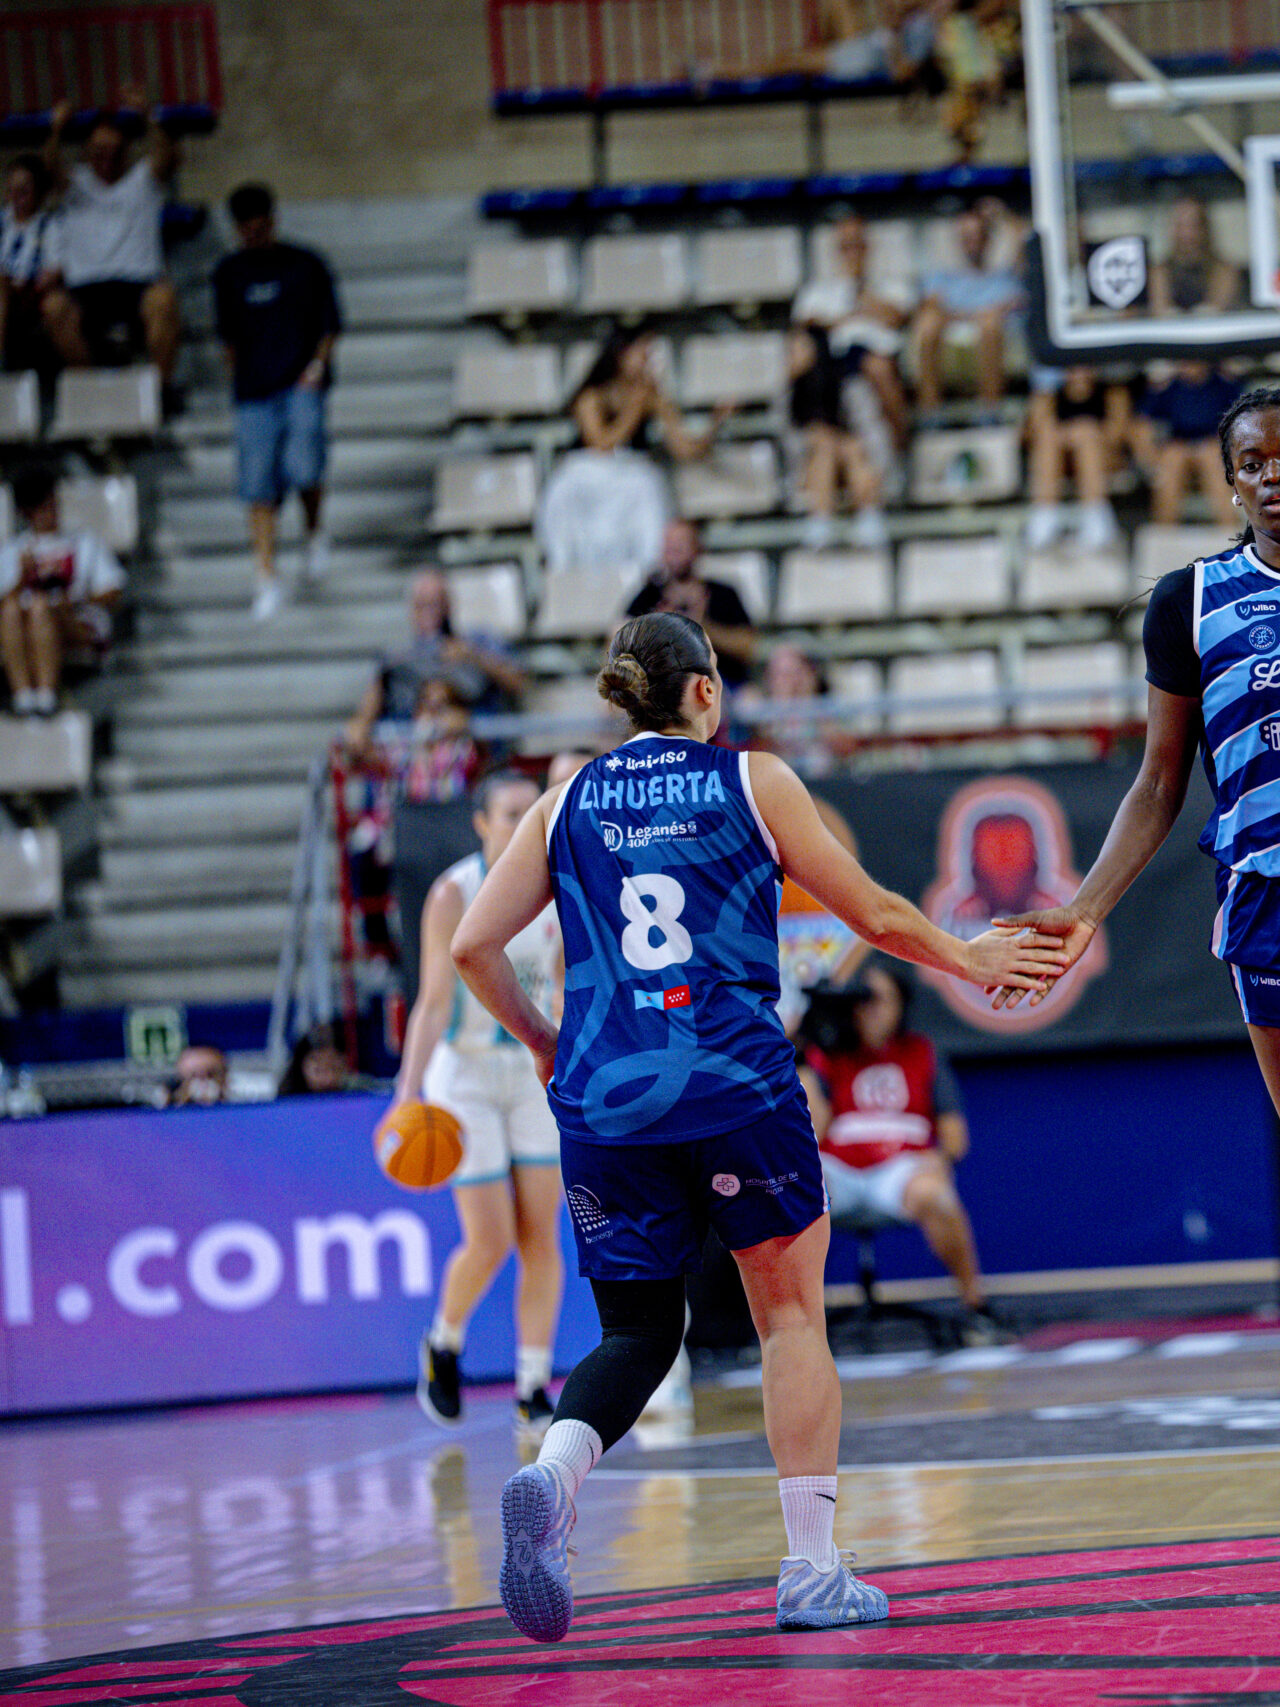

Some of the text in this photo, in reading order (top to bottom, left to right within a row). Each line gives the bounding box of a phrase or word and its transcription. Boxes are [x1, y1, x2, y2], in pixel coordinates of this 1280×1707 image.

[627, 821, 687, 839] Leganés
[626, 839, 649, 848] 400
[620, 873, 693, 970] 8
